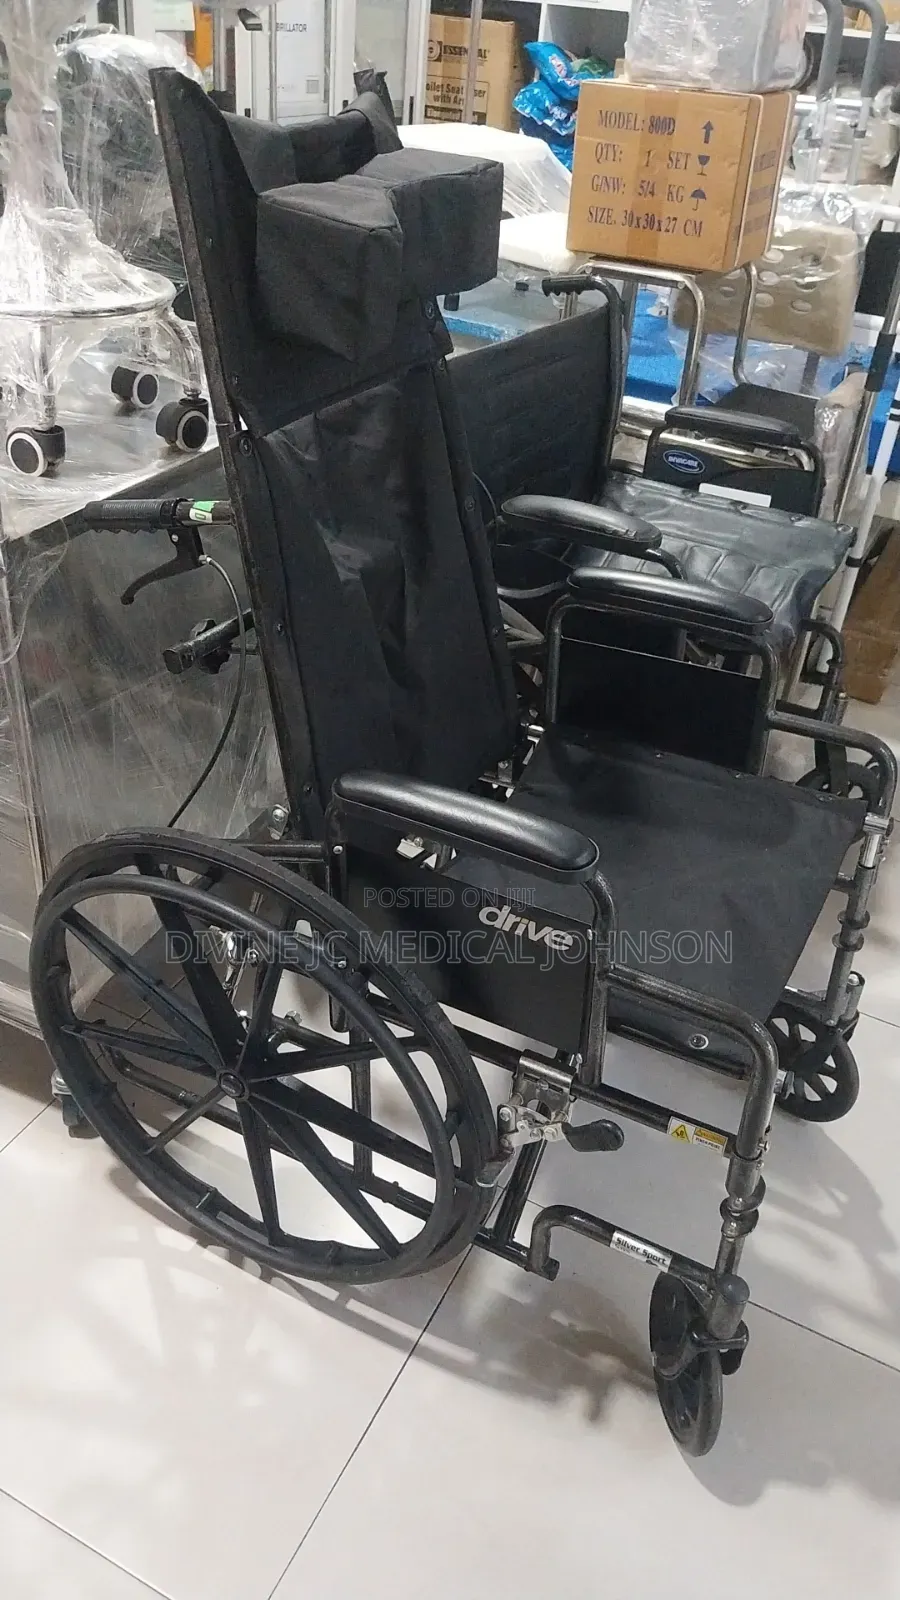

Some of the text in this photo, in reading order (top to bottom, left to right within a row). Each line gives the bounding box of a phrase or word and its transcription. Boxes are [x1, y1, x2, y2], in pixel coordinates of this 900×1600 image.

[598, 110, 676, 136] MODEL: 800D
[595, 142, 691, 170] QTY: 1 SET
[638, 180, 656, 198] 5/4
[667, 184, 684, 203] KG
[683, 219, 703, 238] CM
[478, 905, 574, 951] drive
[616, 1236, 640, 1253] Silver
[642, 1248, 667, 1265] Sport
